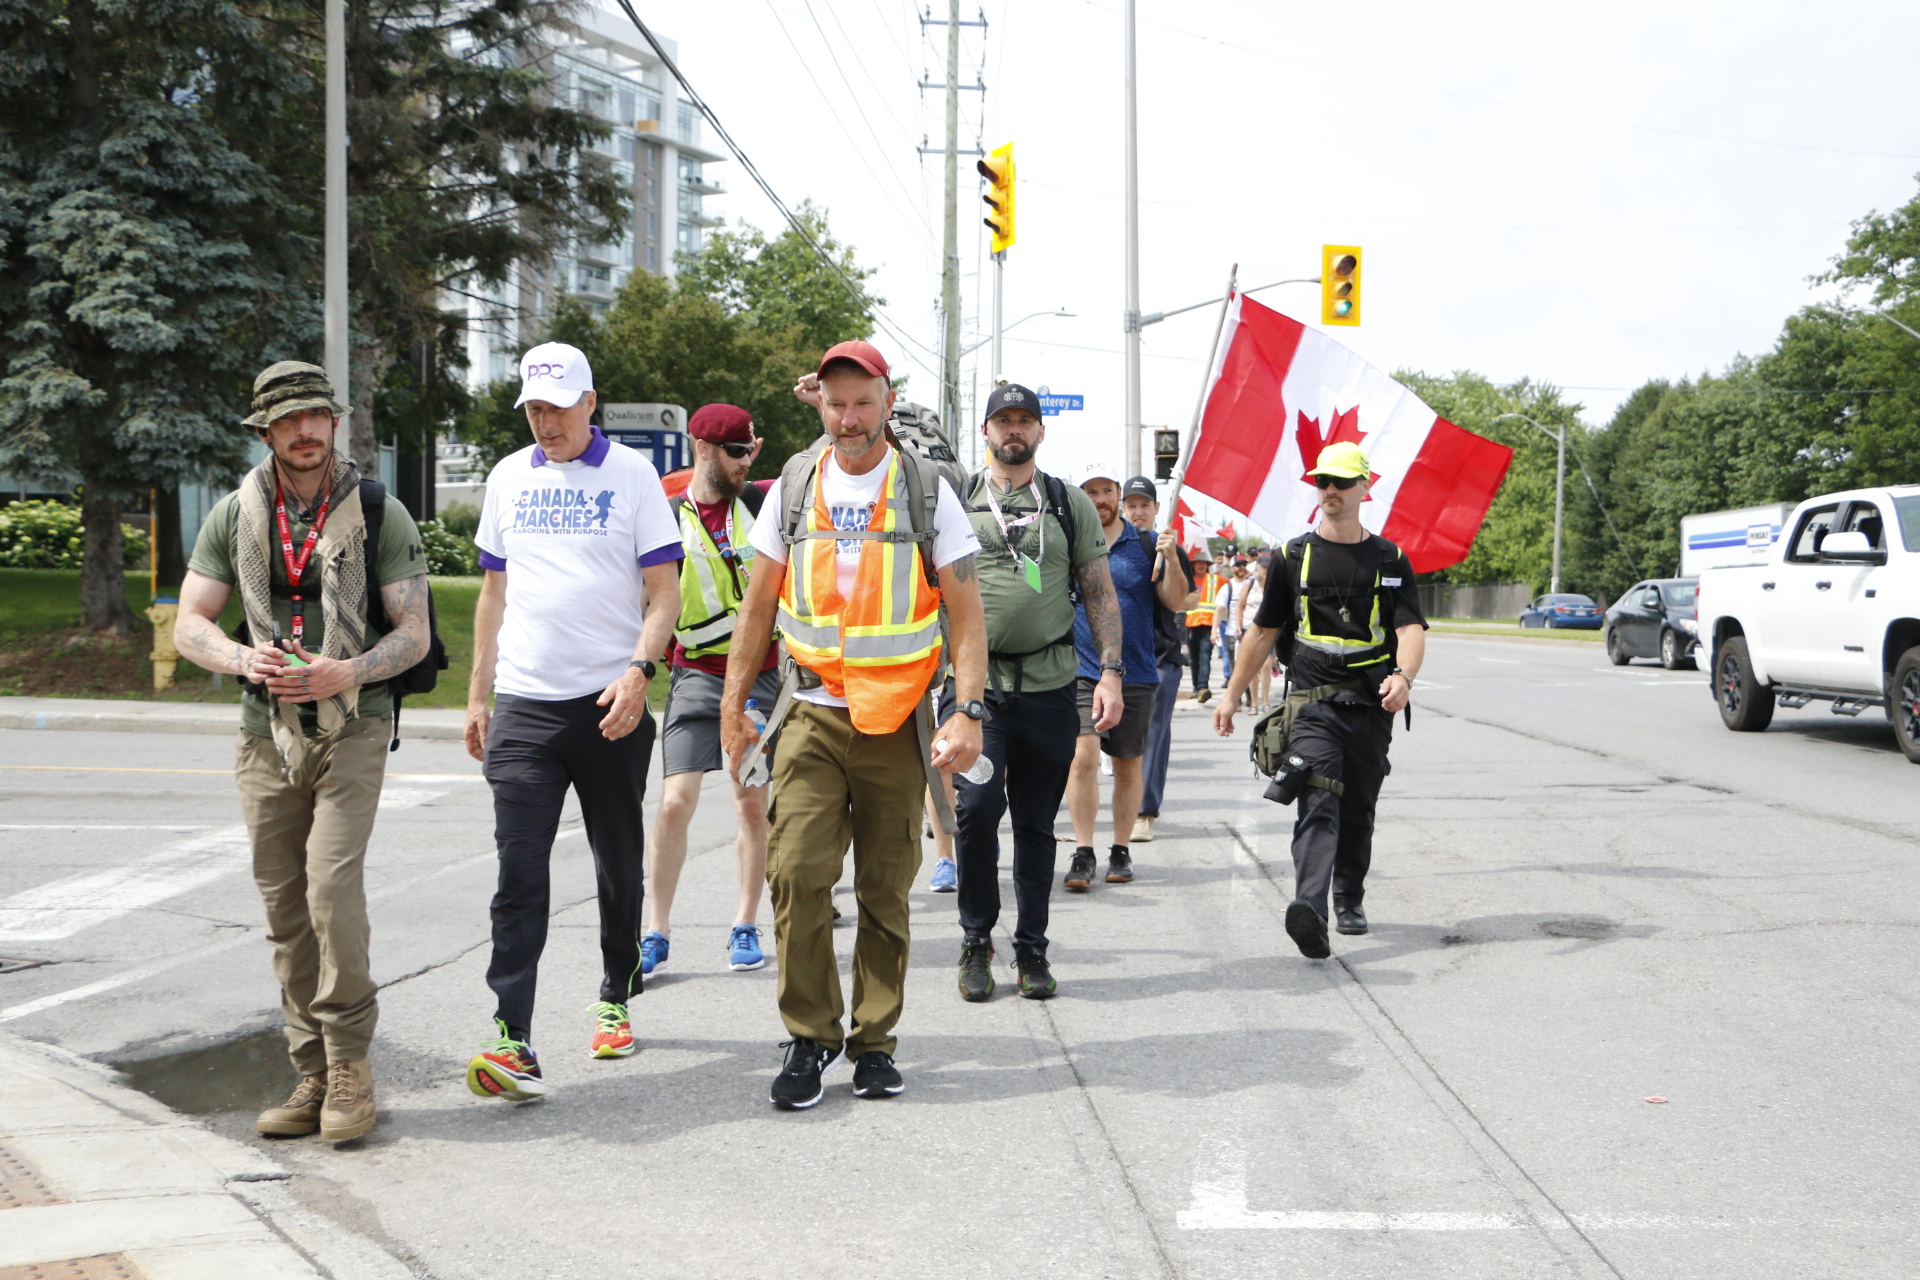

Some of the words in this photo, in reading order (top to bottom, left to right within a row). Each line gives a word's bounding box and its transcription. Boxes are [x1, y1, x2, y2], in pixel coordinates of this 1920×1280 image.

[528, 364, 564, 381] PPC
[1038, 396, 1070, 410] nterey
[1072, 399, 1082, 408] Dr.
[606, 410, 655, 420] Qualicum
[518, 488, 586, 509] CANADA
[513, 508, 593, 528] MARCHES
[512, 527, 550, 535] MARCHING
[552, 527, 571, 535] WITH
[573, 528, 608, 536] PURPOSE
